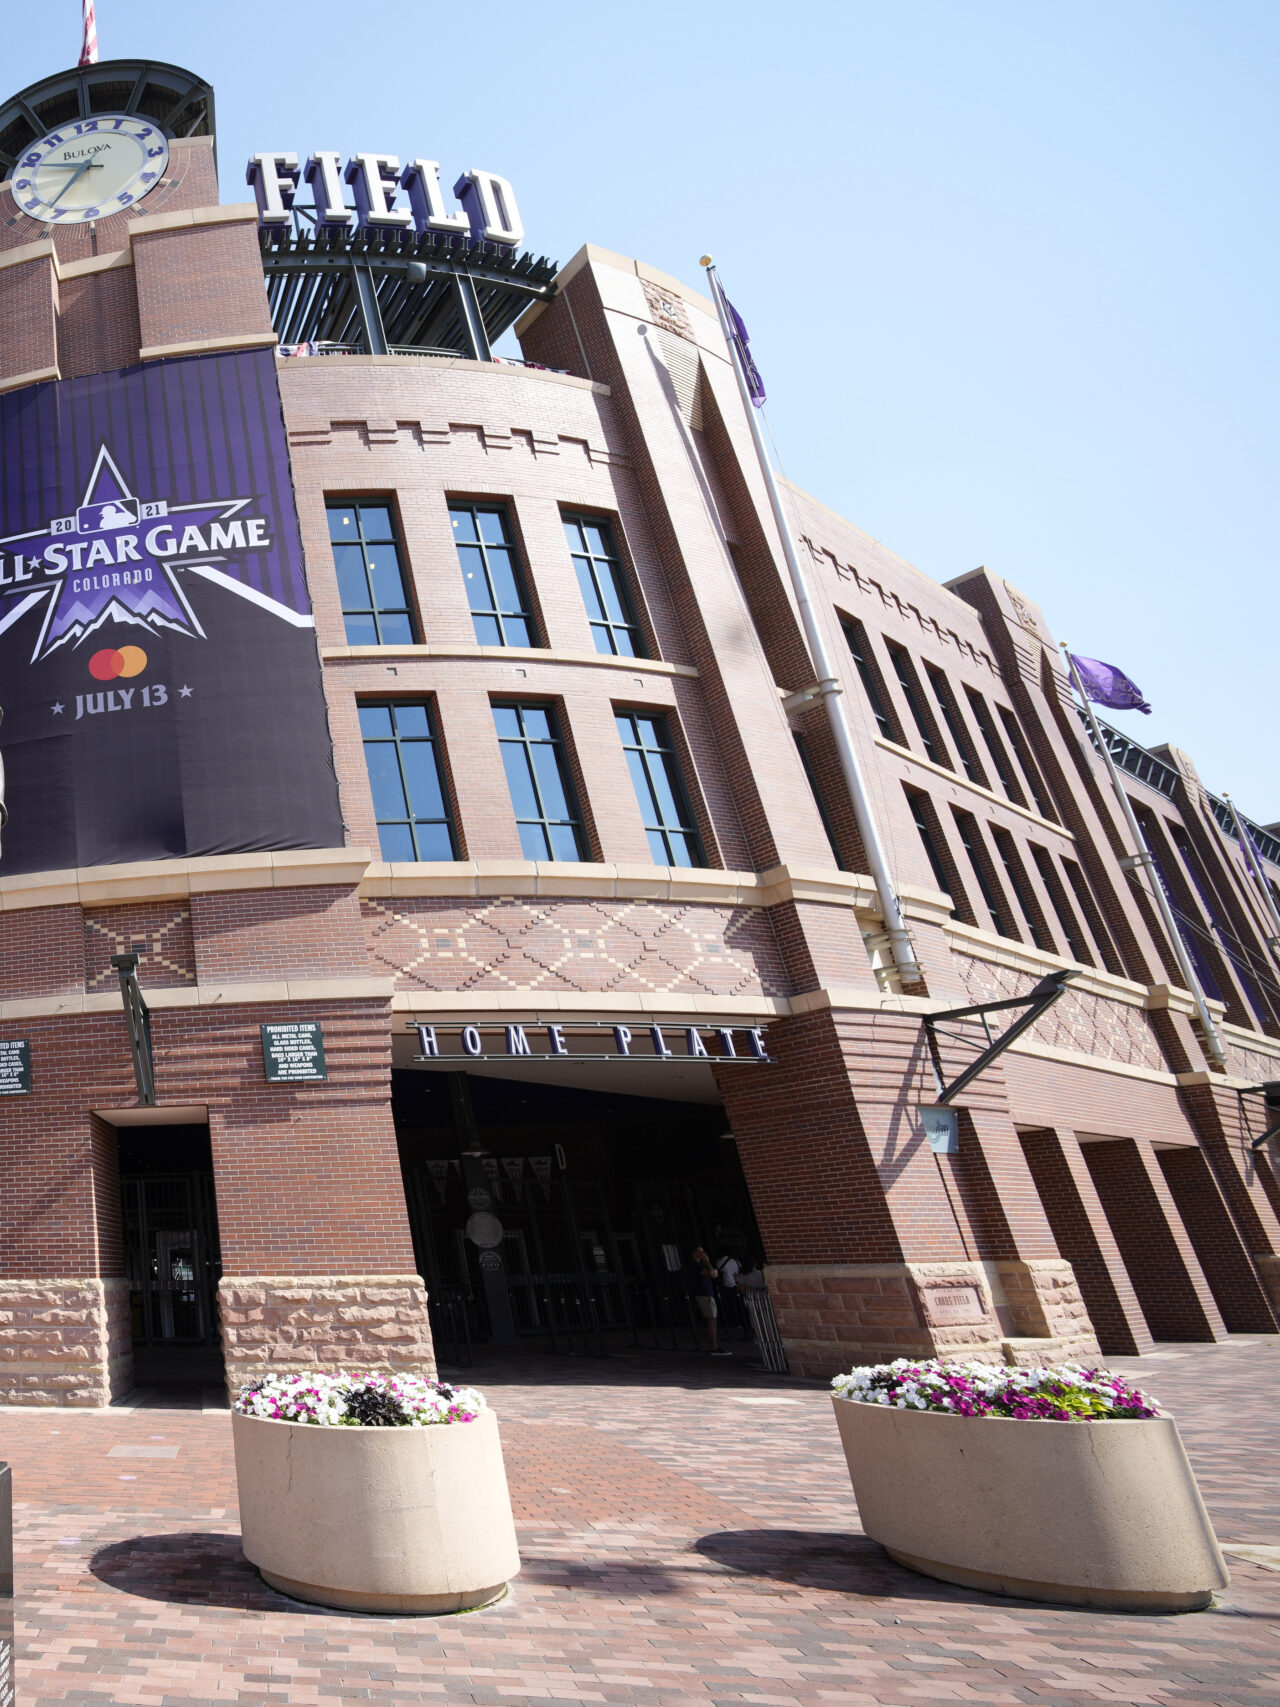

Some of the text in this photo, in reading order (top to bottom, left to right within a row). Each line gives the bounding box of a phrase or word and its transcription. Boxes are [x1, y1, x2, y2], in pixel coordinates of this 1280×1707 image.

[73, 121, 98, 135] 12
[112, 119, 124, 130] 1
[43, 134, 64, 148] 11
[134, 127, 153, 141] 2
[63, 143, 112, 161] BULOVA
[147, 146, 164, 158] 3
[21, 152, 42, 169] 10
[15, 178, 31, 190] 9
[141, 171, 157, 183] 4
[24, 197, 41, 210] 8
[117, 191, 134, 206] 5
[246, 151, 525, 247] FIELD
[50, 208, 68, 220] 7
[84, 207, 100, 218] 6
[55, 504, 161, 534] 20 21
[145, 518, 271, 557] GAME
[72, 568, 154, 594] COLORADO
[74, 684, 169, 720] JULY 13
[266, 1024, 316, 1033] PROHIBITED ITEMS
[418, 1026, 770, 1060] HOME PLATE
